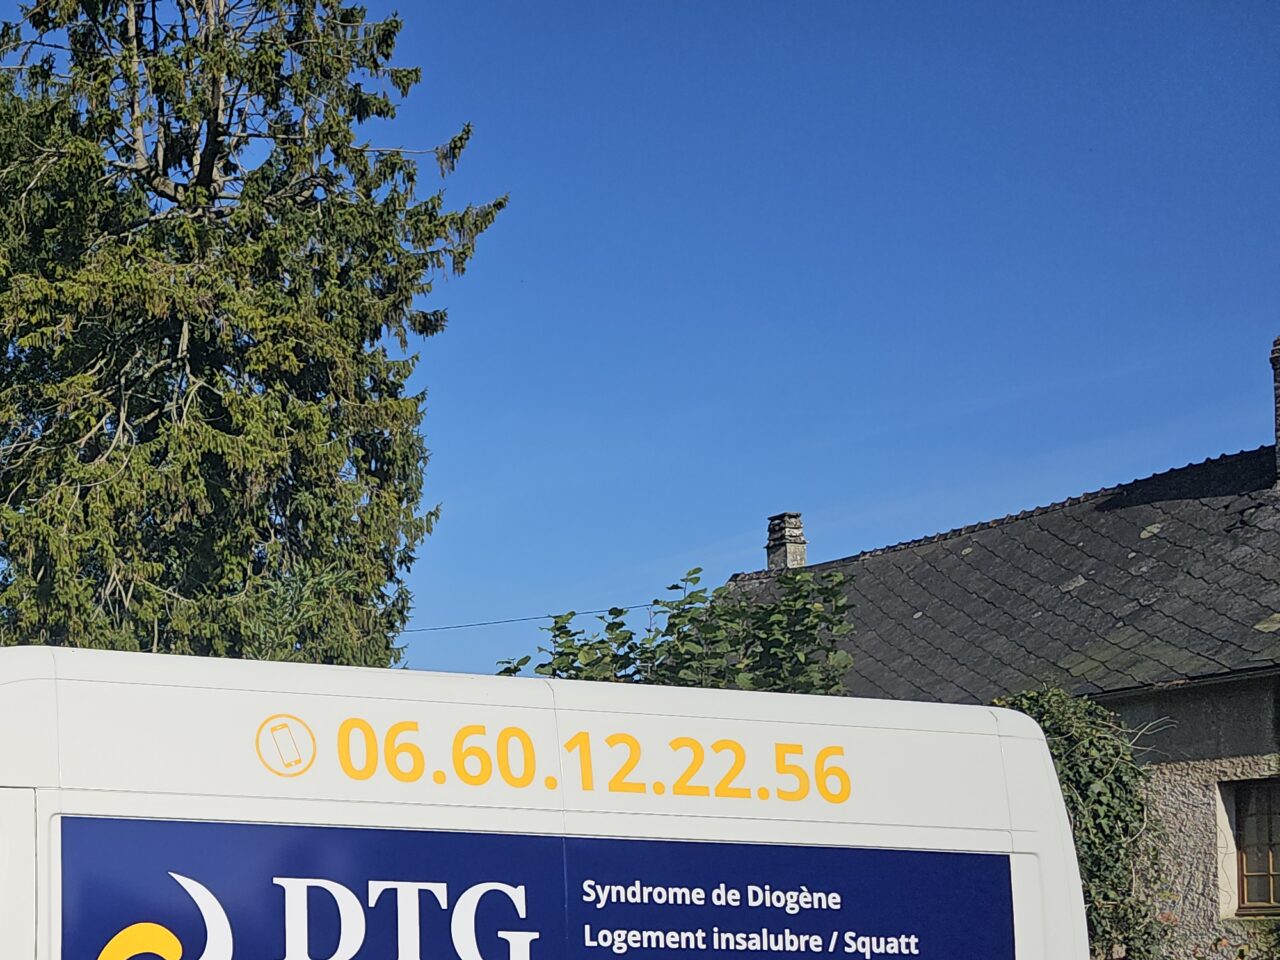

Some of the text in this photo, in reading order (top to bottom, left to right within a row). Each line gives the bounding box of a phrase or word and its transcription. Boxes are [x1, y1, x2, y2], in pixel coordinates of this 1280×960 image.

[337, 717, 852, 804] 06.60.12.22.56
[582, 879, 841, 914] Syndrome de Diogène
[584, 924, 920, 960] Logement insalubre / Squatt
